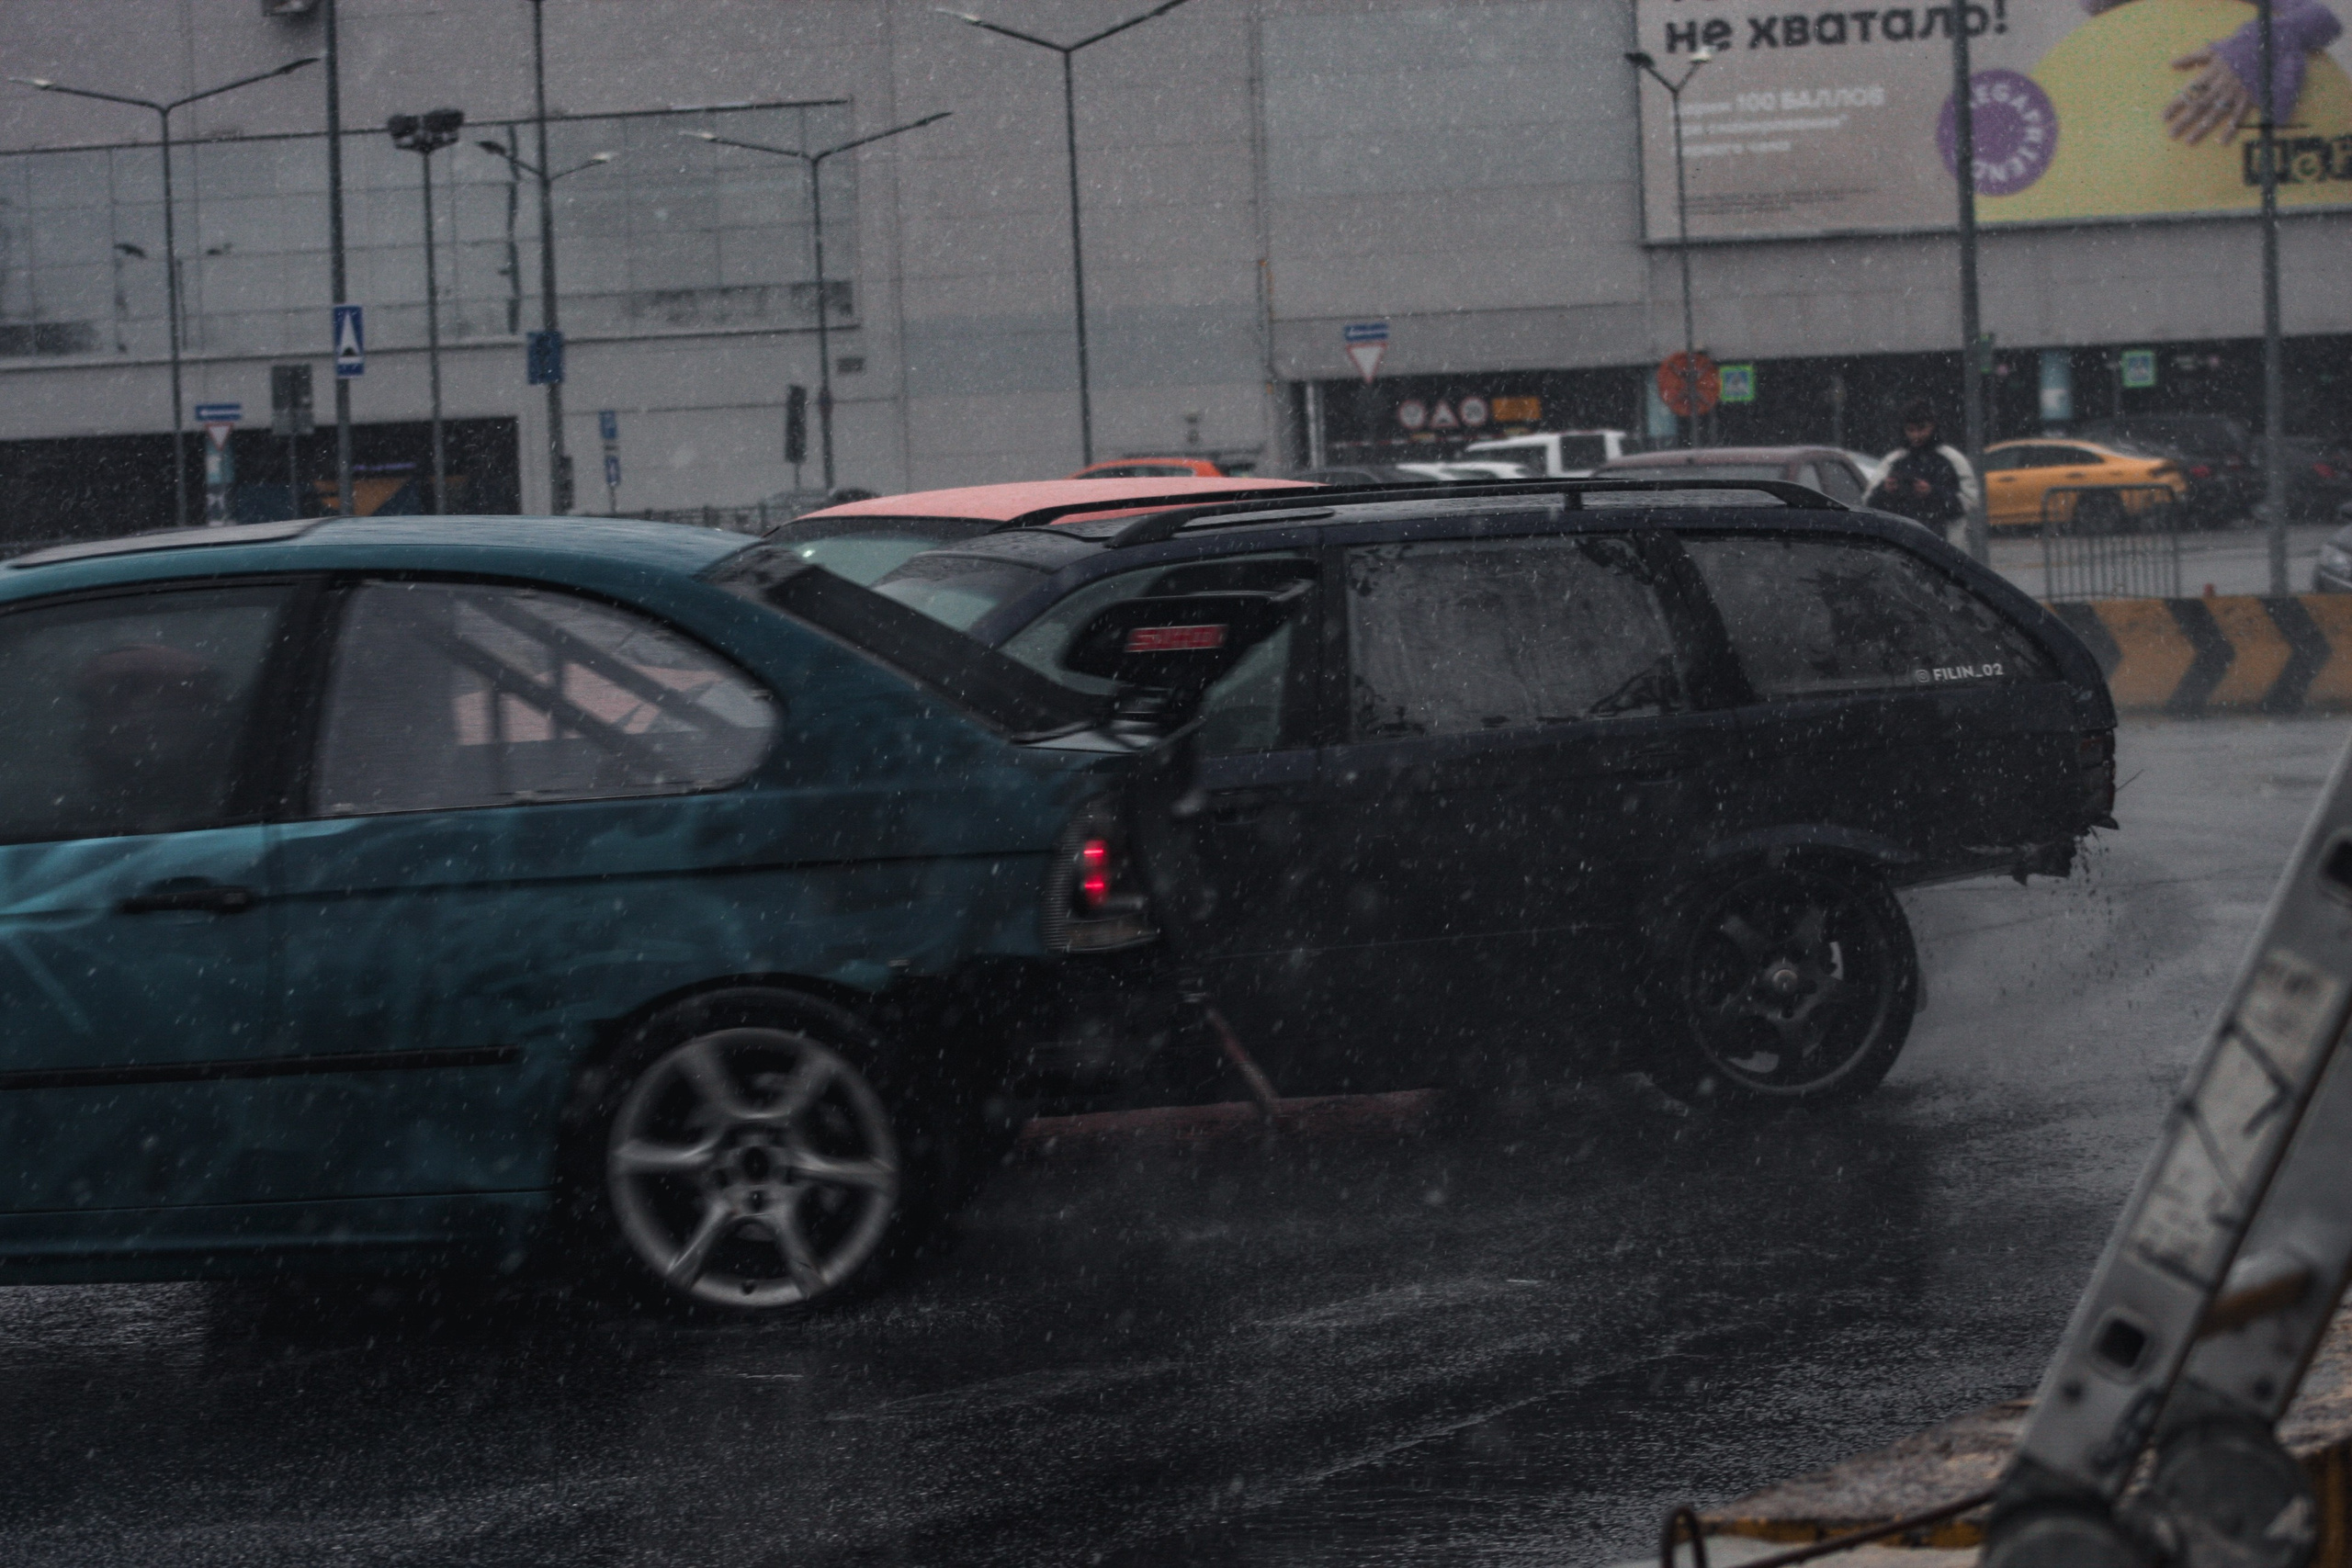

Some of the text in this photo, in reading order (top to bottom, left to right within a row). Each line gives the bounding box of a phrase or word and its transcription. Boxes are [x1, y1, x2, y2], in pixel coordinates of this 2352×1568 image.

[1665, 0, 2007, 53] не хватало!
[1933, 664, 2004, 681] FILIN_02
